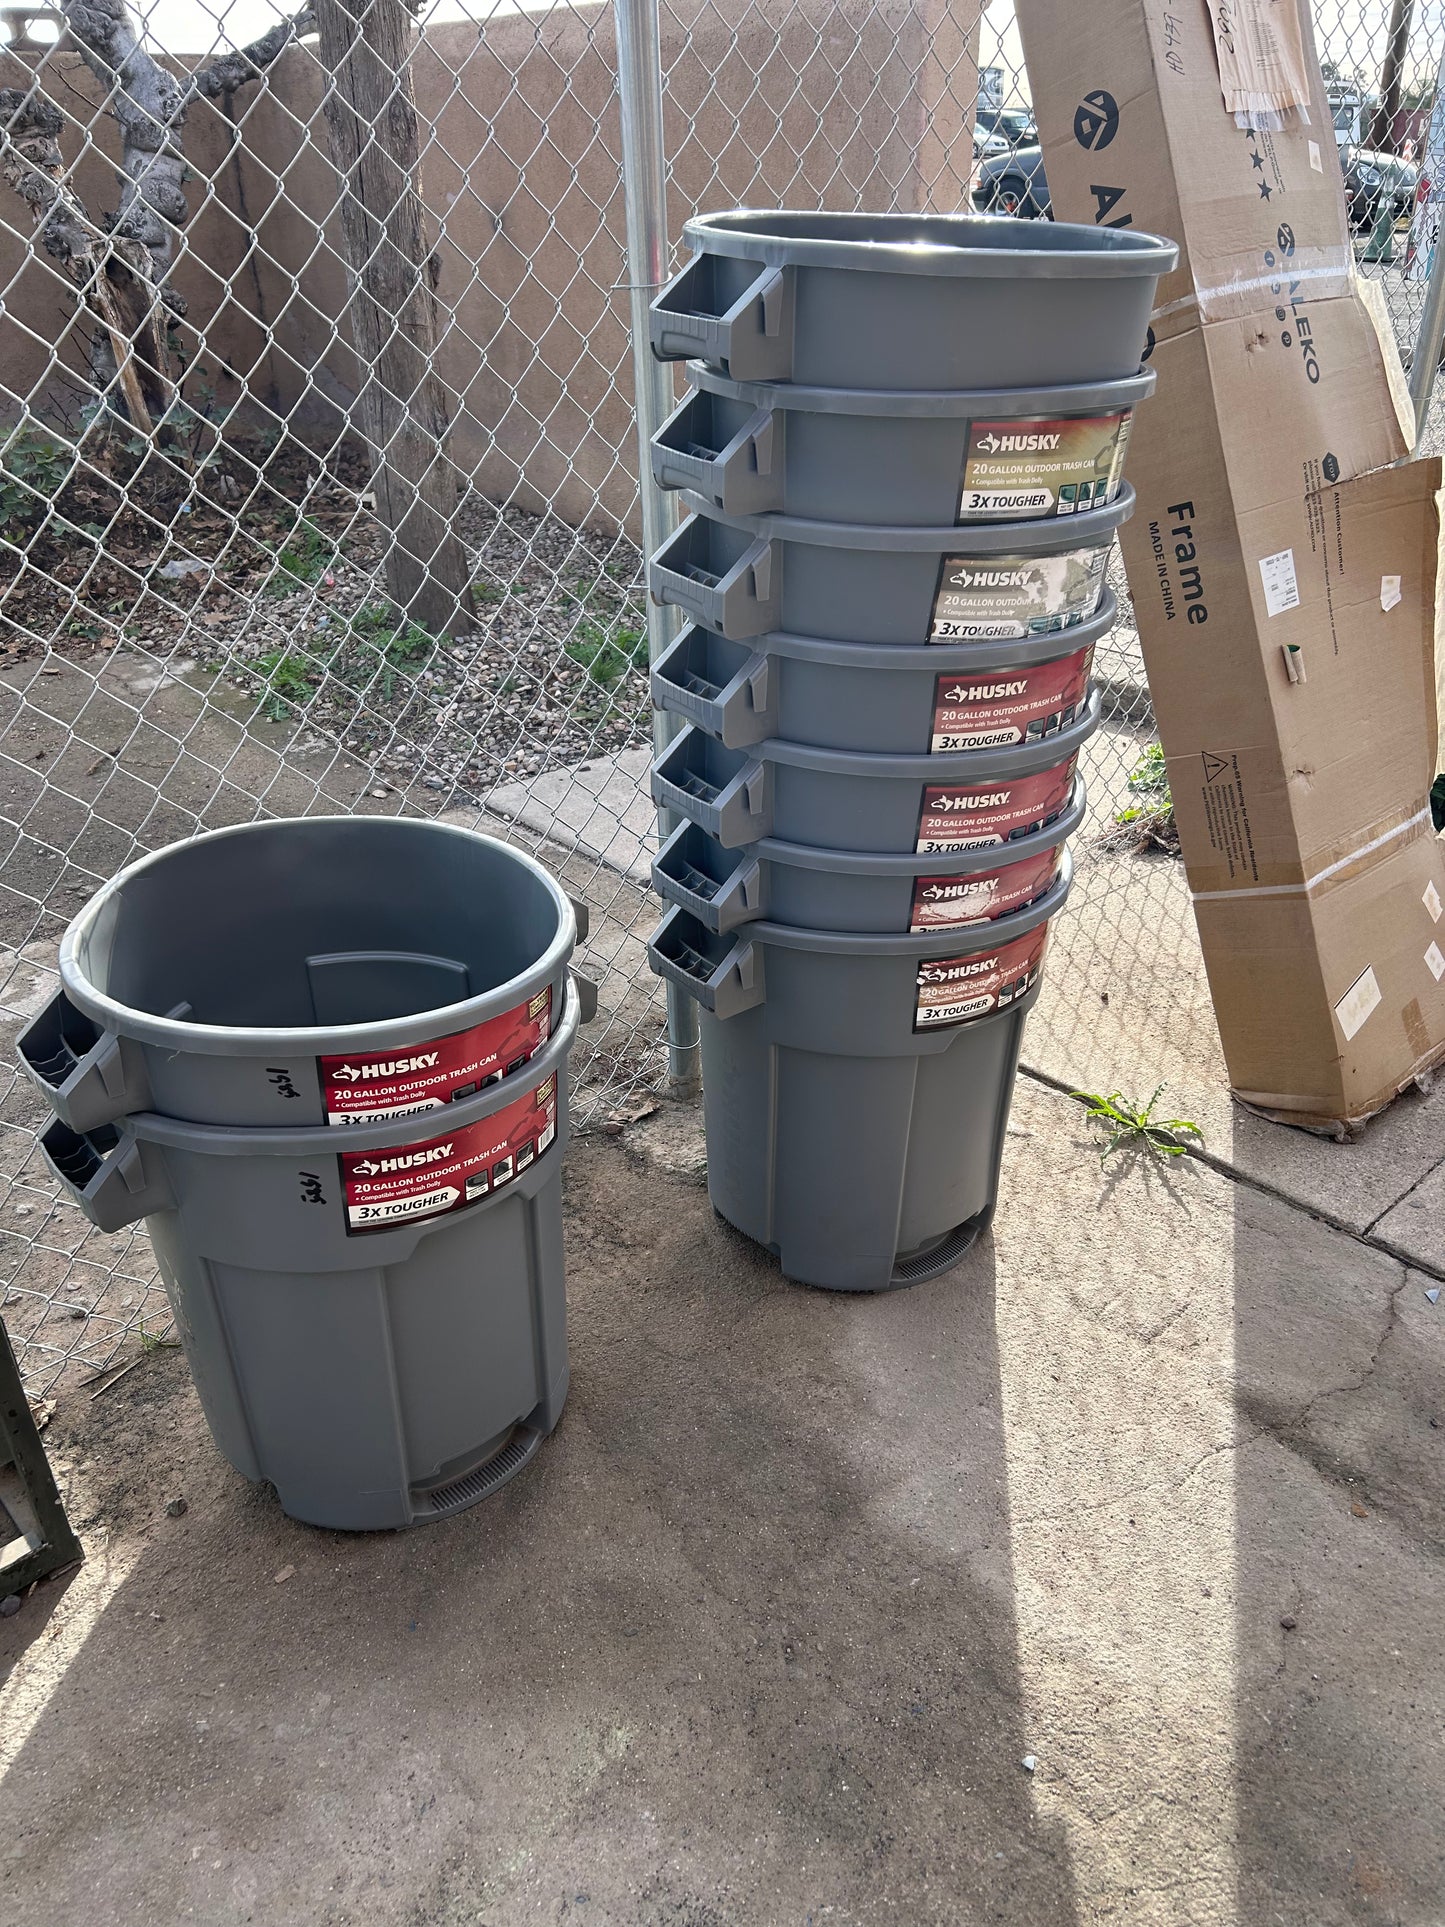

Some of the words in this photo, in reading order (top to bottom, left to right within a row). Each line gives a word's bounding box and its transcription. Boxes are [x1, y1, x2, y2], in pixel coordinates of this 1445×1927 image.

[1289, 279, 1320, 384] ALEKO
[1000, 434, 1060, 451] HUSKY
[973, 463, 987, 474] 20
[989, 465, 1023, 474] GALLON
[1025, 463, 1061, 473] OUTDOOR
[1062, 461, 1082, 470] TRASH
[1083, 459, 1095, 468] CAN
[1327, 457, 1336, 478] STOP
[976, 478, 1004, 486] Compatible
[992, 494, 1046, 507] TOUGHER
[1149, 521, 1165, 561] MADE
[1167, 500, 1208, 625] Frame
[1337, 532, 1345, 576] Customer!
[973, 571, 1033, 587] HUSKY
[1157, 562, 1168, 577] IN
[944, 596, 960, 605] 20
[961, 598, 993, 606] GALLON
[1160, 579, 1176, 621] CHINA
[962, 625, 1016, 636] TOUGHER
[968, 680, 1027, 700] HUSKY
[941, 711, 957, 721] 20
[957, 710, 991, 720] GALLON
[993, 704, 1028, 716] OUTDOOR
[1029, 698, 1050, 710] TRASH
[1050, 693, 1062, 703] CAN
[961, 732, 1014, 747] TOUGHER
[953, 791, 1011, 810] HUSKY
[927, 819, 941, 827] 20
[942, 817, 975, 827] GALLON
[976, 813, 1011, 825] OUTDOOR
[1012, 808, 1032, 818] TRASH
[1032, 802, 1045, 813] CAN
[1236, 780, 1246, 807] Warning
[1243, 818, 1253, 849] California
[1249, 850, 1259, 881] Residents
[945, 838, 996, 852] TOUGHER
[944, 877, 999, 898] HUSKY
[1001, 892, 1021, 903] TRASH
[1021, 885, 1033, 895] CAN
[925, 988, 937, 997] 20
[938, 985, 968, 995] GALLON
[1001, 967, 1018, 979] TRASH
[1018, 959, 1029, 970] CAN
[948, 957, 999, 980] HUSKY
[943, 998, 988, 1016] TOUGHER
[334, 1090, 352, 1100] 20
[354, 1086, 397, 1099] GALLON
[399, 1074, 447, 1092] OUTDOOR
[449, 1062, 478, 1079] TRASH
[479, 1052, 497, 1067] CAN
[362, 1052, 439, 1079] HUSKY
[341, 1098, 377, 1109] Compatible
[378, 1096, 392, 1106] with
[392, 1094, 409, 1104] Trash
[409, 1090, 426, 1102] Dolly
[366, 1103, 434, 1123] TOUGHER
[354, 1183, 371, 1194] 20
[372, 1178, 414, 1191] GALLON
[415, 1162, 462, 1182] OUTDOOR
[463, 1150, 490, 1167] TRASH
[491, 1140, 508, 1154] CAN
[381, 1143, 454, 1173] HUSKY
[360, 1191, 395, 1202] Compatible
[396, 1188, 410, 1198] with
[410, 1185, 426, 1196] Trash
[426, 1180, 442, 1192] Dolly
[384, 1191, 449, 1215] TOUGHER
